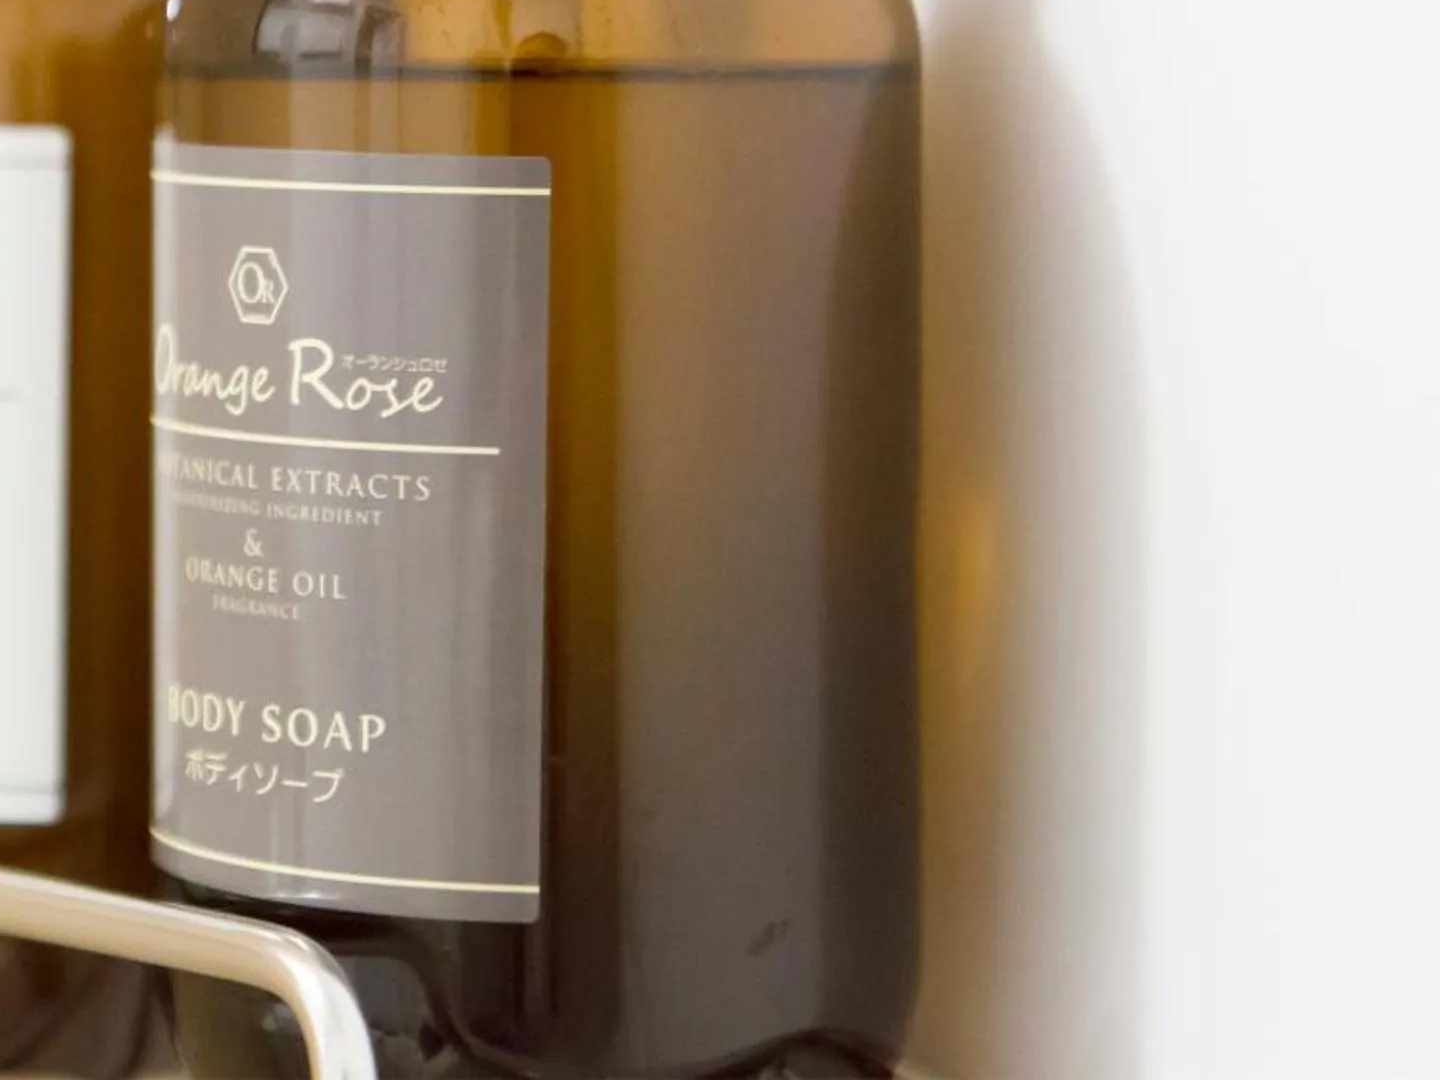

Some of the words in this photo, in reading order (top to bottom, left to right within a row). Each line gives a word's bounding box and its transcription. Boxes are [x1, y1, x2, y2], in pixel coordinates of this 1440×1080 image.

[154, 324, 275, 416] Orange
[287, 337, 444, 420] Rose
[271, 465, 432, 502] EXTRACTS
[266, 501, 383, 526] INGREDIENT
[243, 528, 265, 557] &
[184, 556, 278, 594] ORANGE
[292, 570, 347, 601] OIL
[168, 685, 246, 737] BODY
[261, 703, 387, 754] SOAP
[184, 748, 346, 804] ボディソープ
